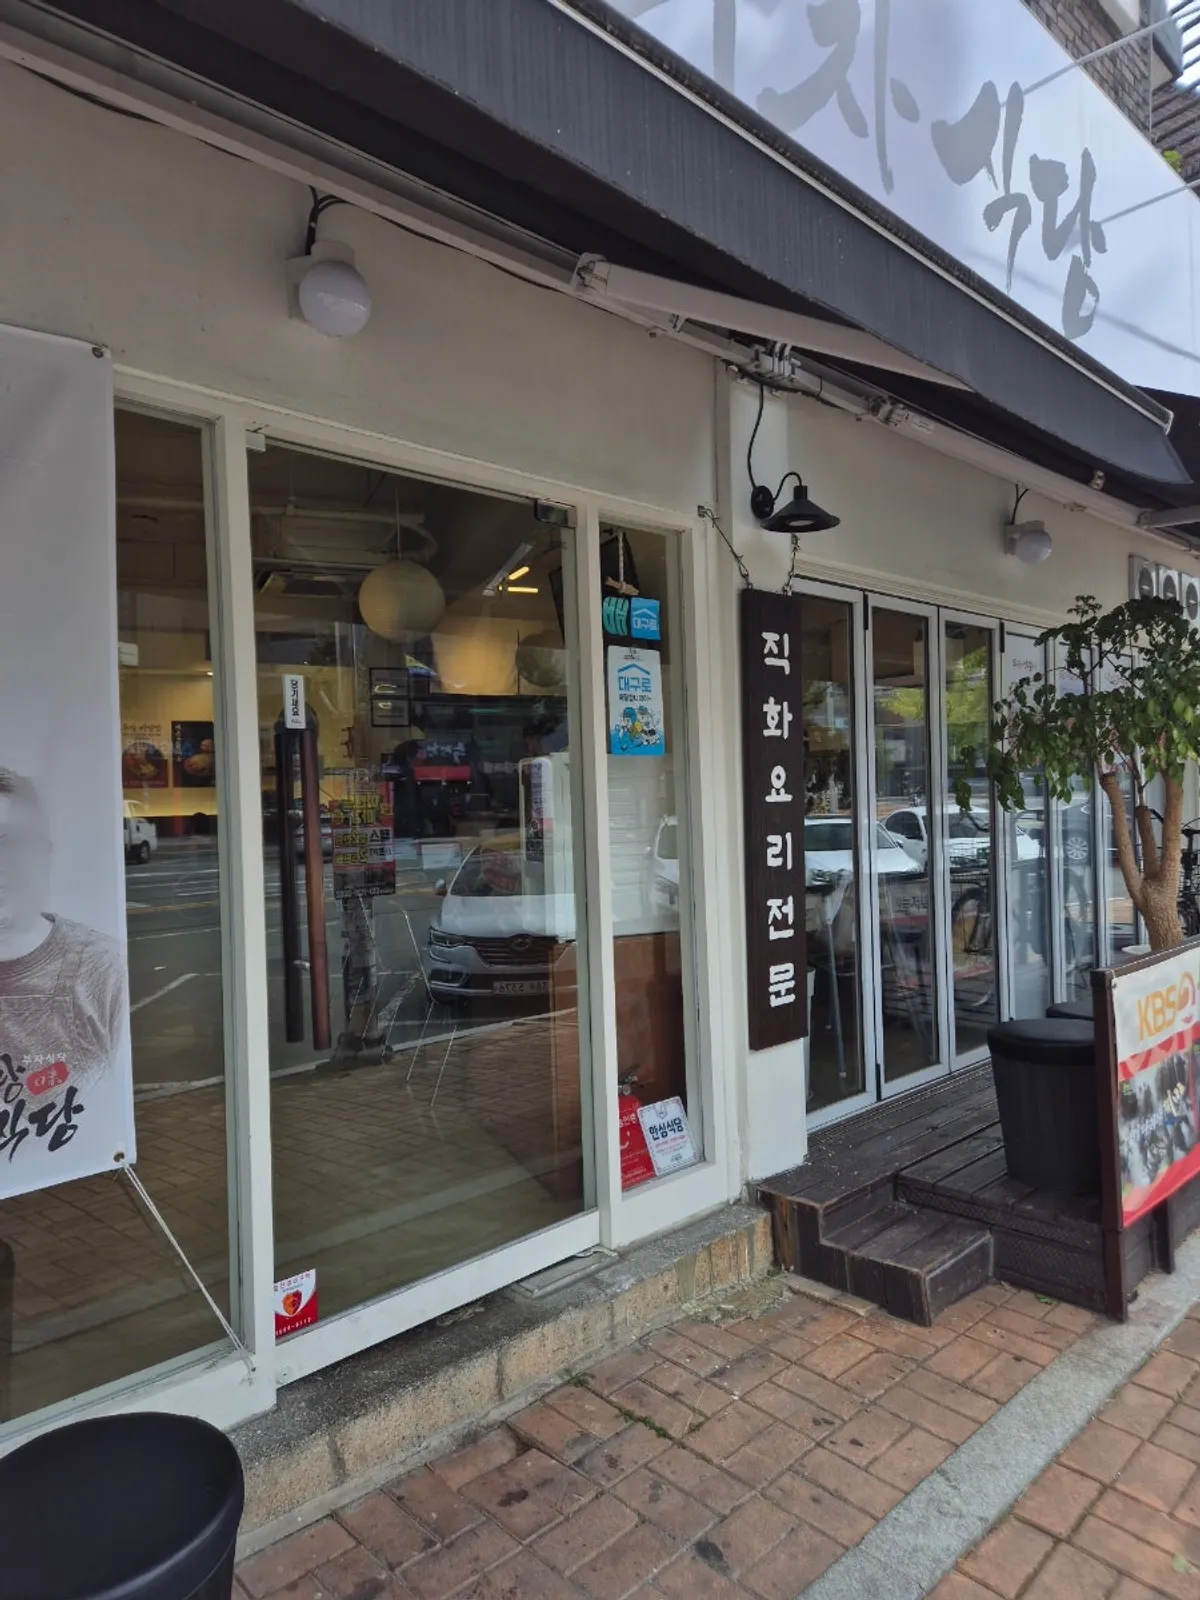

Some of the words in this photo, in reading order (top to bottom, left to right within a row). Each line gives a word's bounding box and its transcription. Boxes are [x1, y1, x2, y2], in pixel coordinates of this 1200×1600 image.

[618, 676, 652, 693] 대구로
[1137, 984, 1176, 1041] KBS
[649, 1117, 684, 1141] 안심식당
